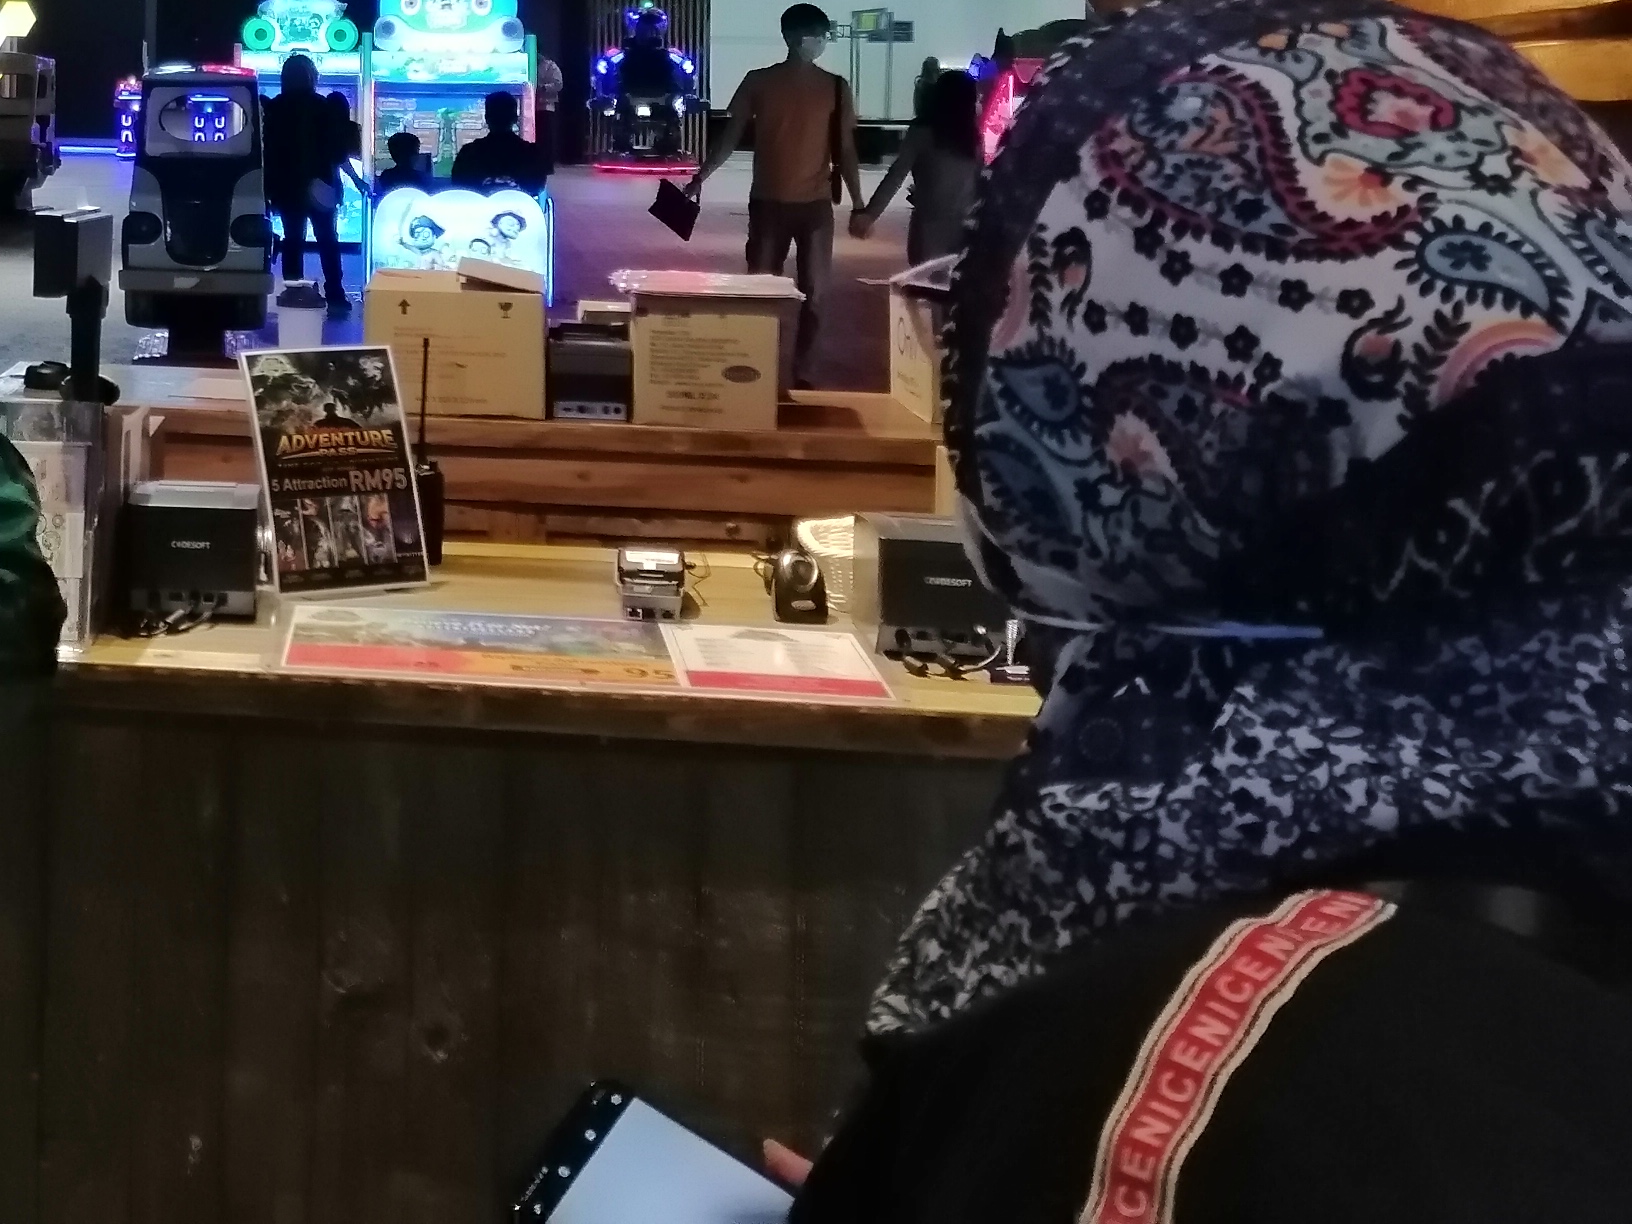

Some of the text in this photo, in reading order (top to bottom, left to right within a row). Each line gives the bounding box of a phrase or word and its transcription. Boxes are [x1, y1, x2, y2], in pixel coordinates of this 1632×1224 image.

[276, 428, 399, 457] ADVENTURE
[283, 476, 349, 492] Attraction
[349, 467, 408, 493] RM95
